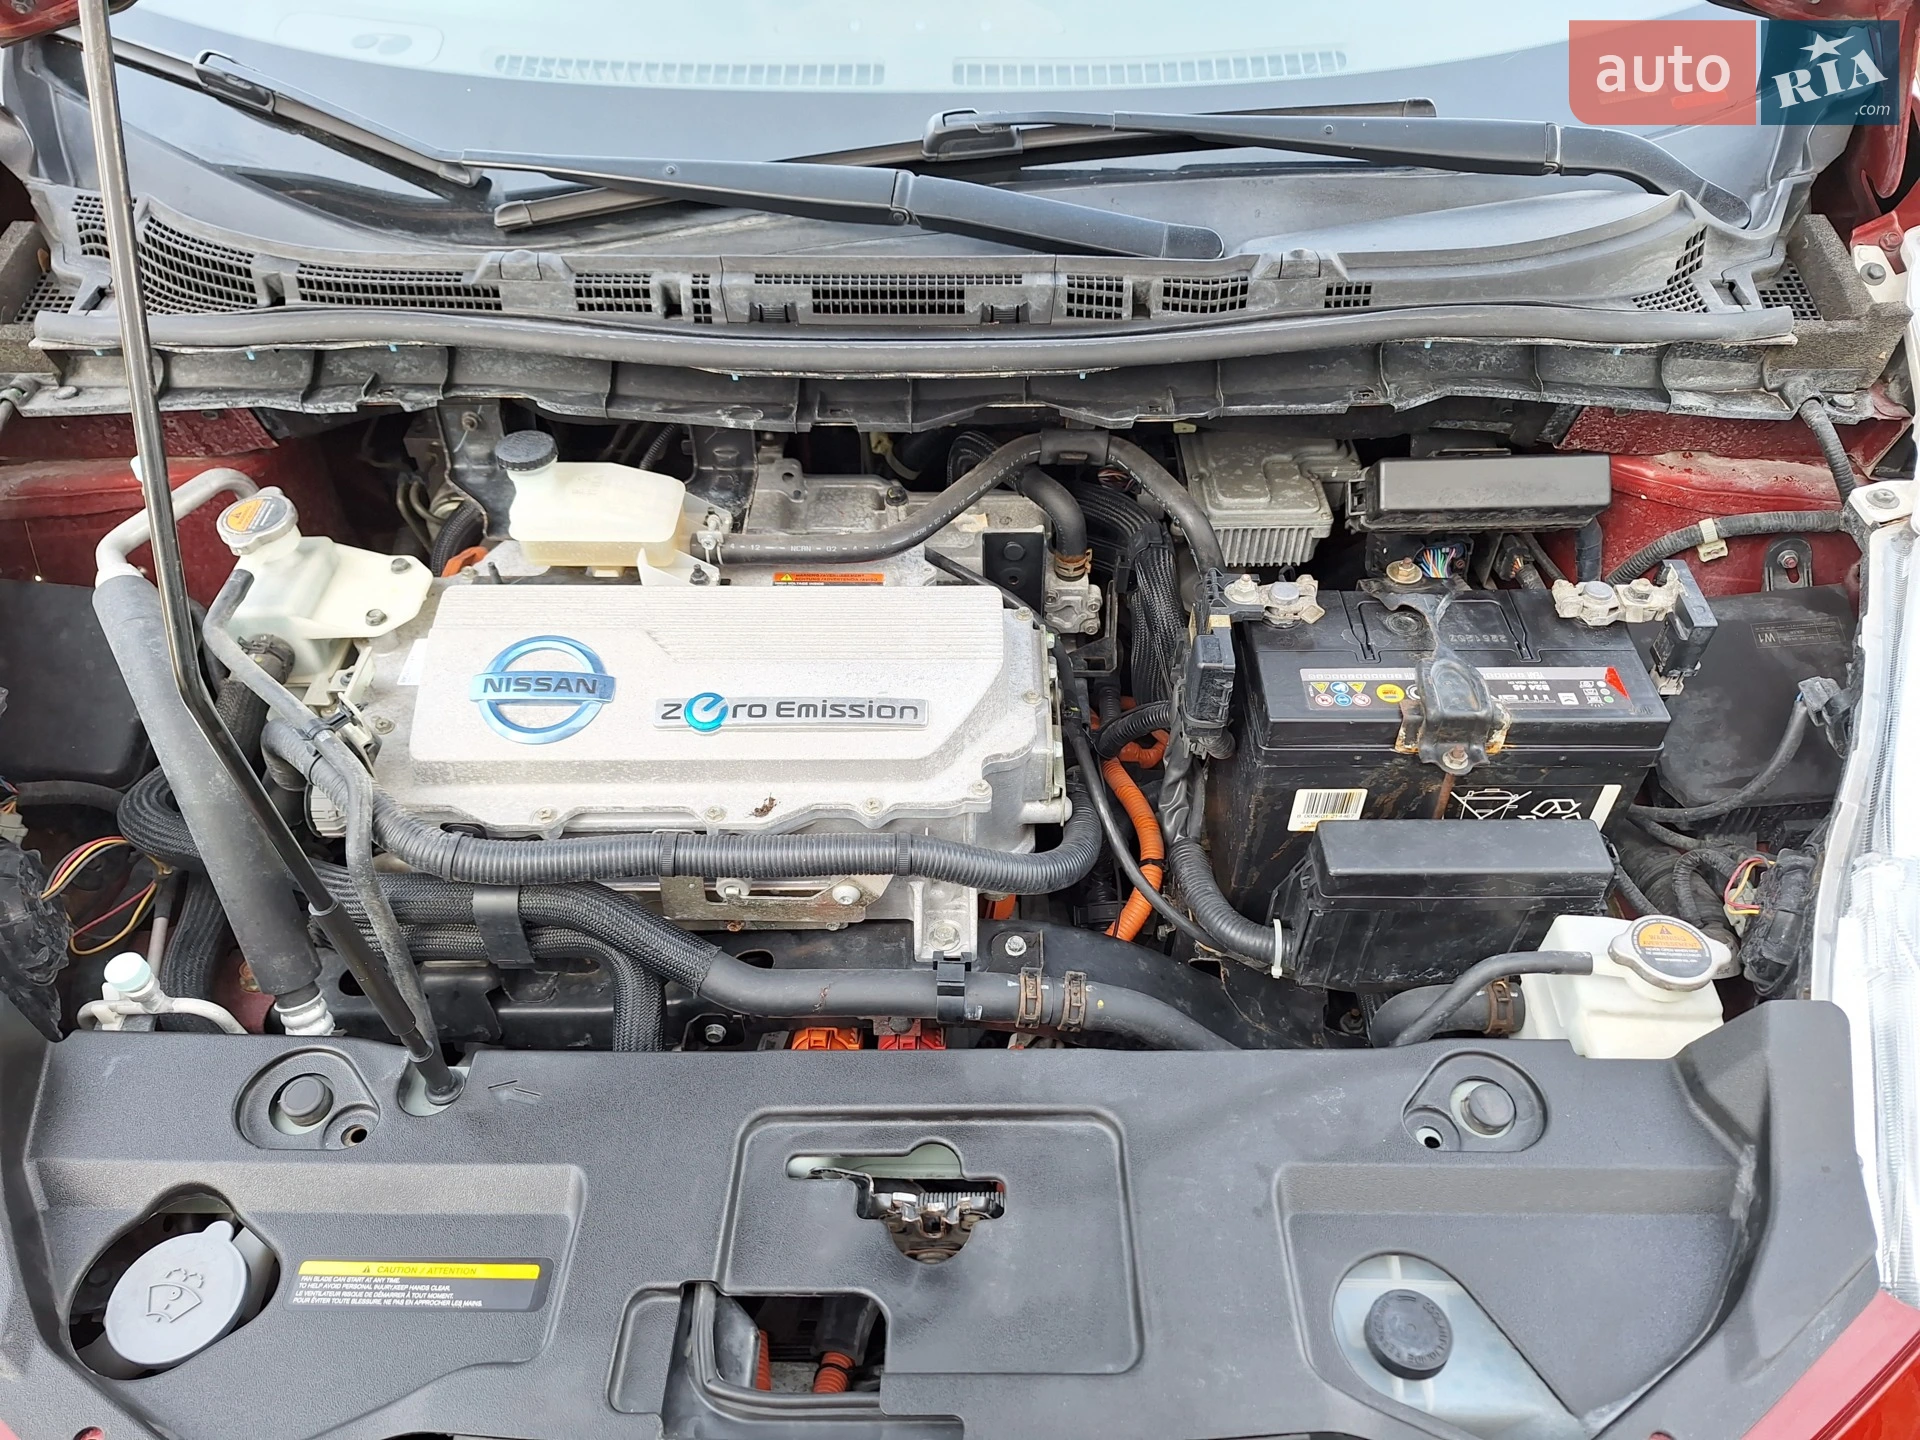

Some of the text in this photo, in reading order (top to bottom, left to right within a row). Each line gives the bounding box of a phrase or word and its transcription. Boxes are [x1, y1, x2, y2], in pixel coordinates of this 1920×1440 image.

[1758, 632, 1776, 643] W1
[483, 677, 598, 694] NISSAN
[775, 699, 919, 720] Emission
[377, 1266, 418, 1274] CAUTION
[426, 1267, 477, 1276] ATTENTION
